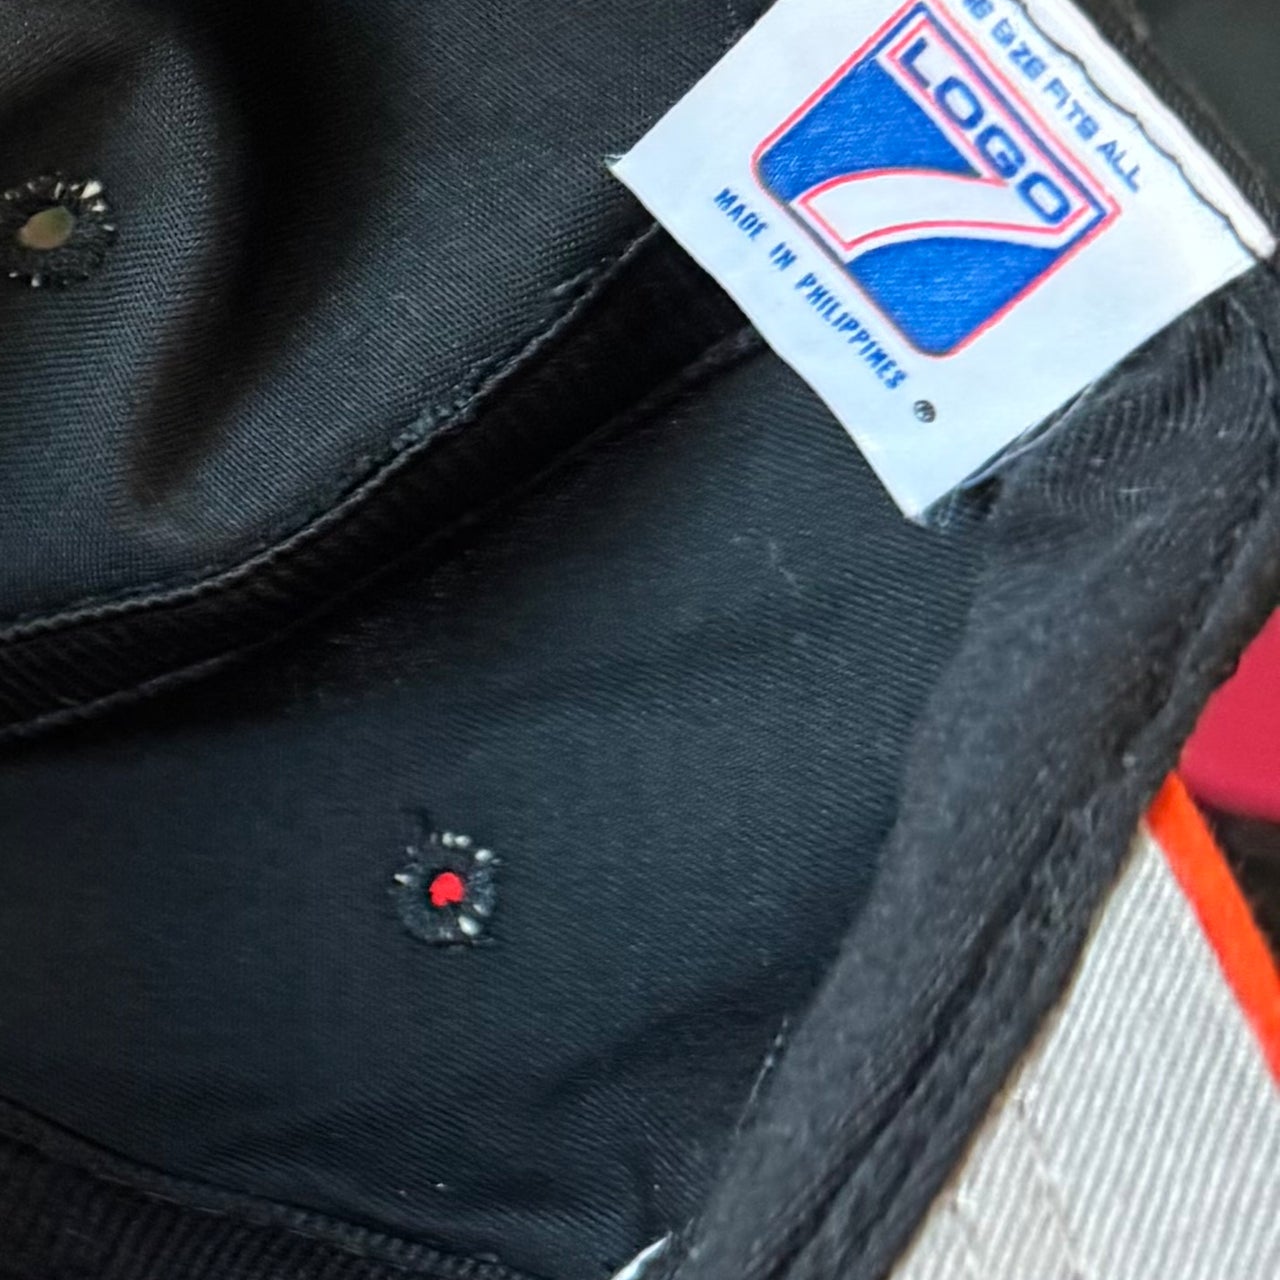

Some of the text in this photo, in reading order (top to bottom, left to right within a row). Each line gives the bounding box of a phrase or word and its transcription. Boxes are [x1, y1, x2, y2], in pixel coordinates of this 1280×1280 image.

[900, 36, 1071, 225] LOGO
[991, 18, 1047, 81] SIZE
[1044, 77, 1100, 141] FITS
[1096, 139, 1140, 193] ALL
[714, 187, 908, 389] MADE IN PHILIPPINES
